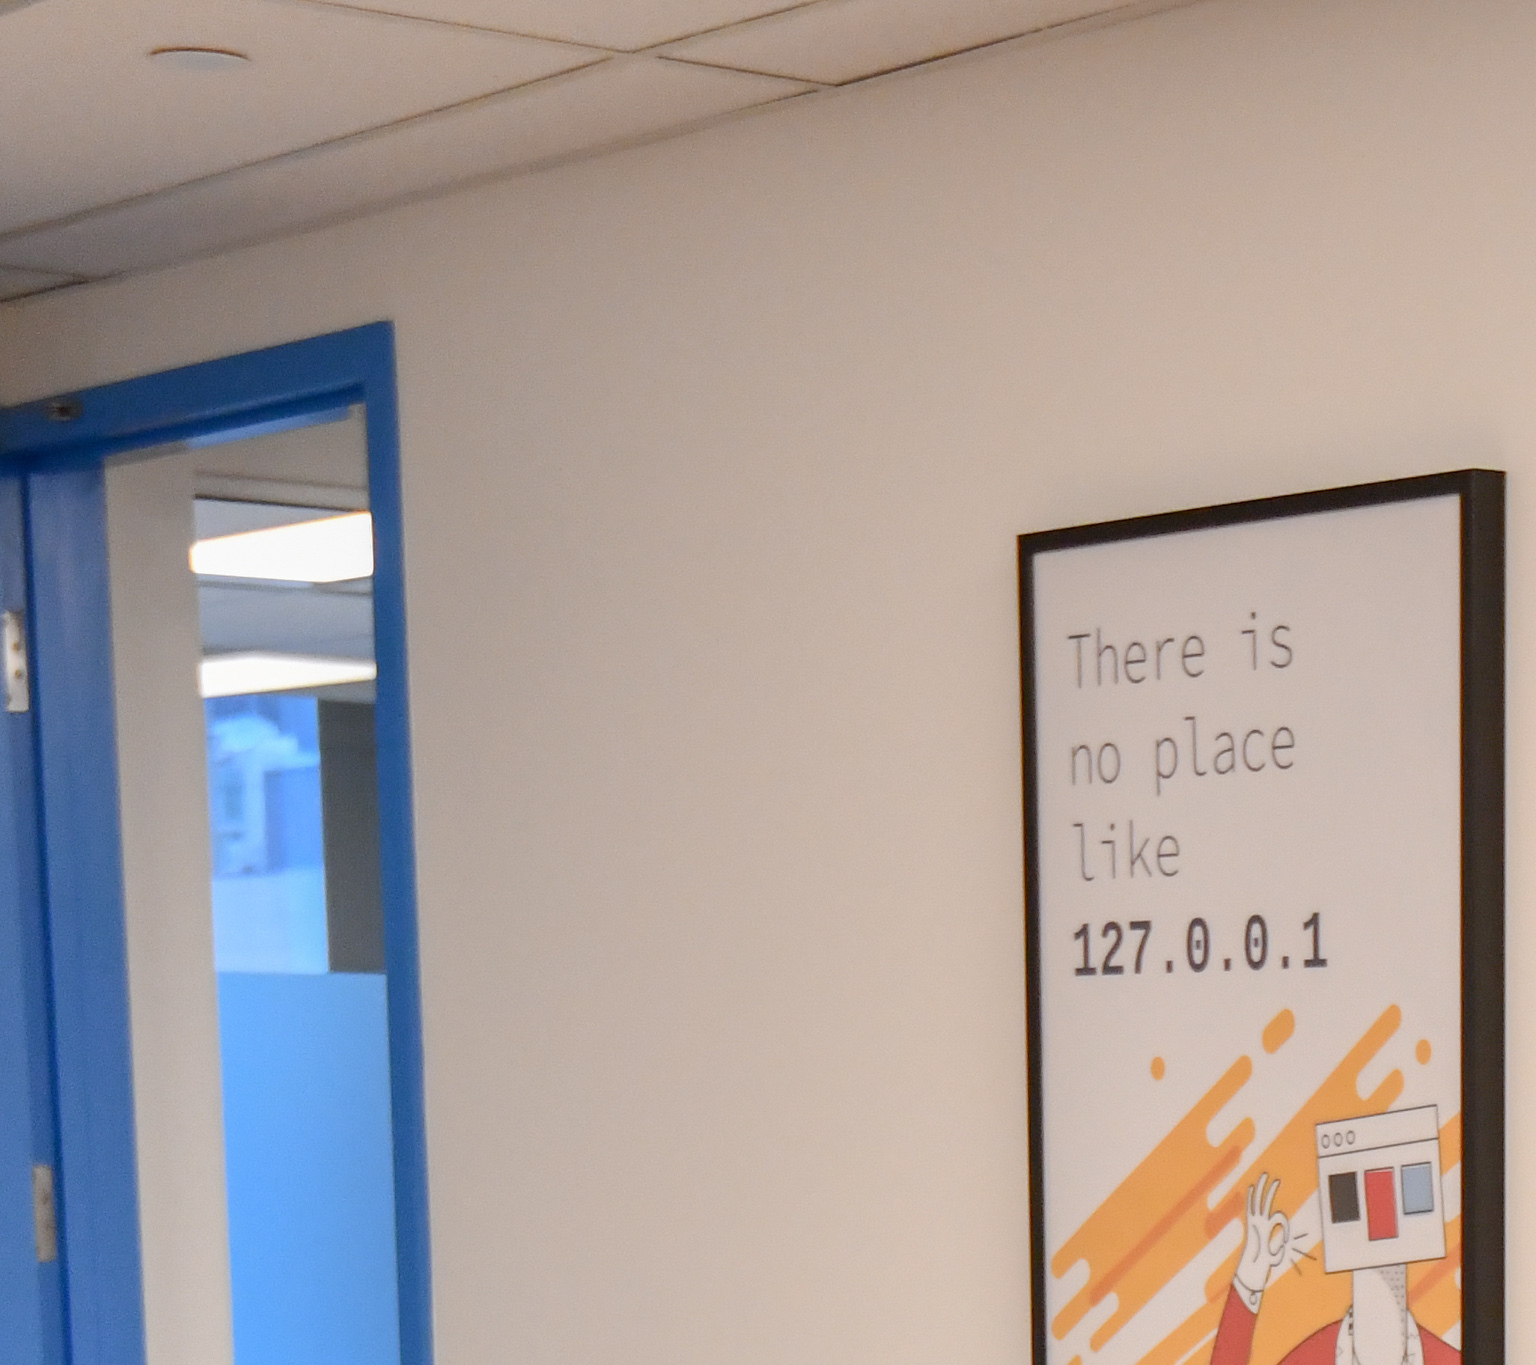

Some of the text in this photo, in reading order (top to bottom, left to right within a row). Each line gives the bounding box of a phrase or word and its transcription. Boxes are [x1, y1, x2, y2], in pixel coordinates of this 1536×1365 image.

[1066, 611, 1295, 689] There is
[1071, 716, 1296, 797] no place
[1072, 819, 1181, 882] like
[1072, 911, 1329, 977] 127.0.0.1
